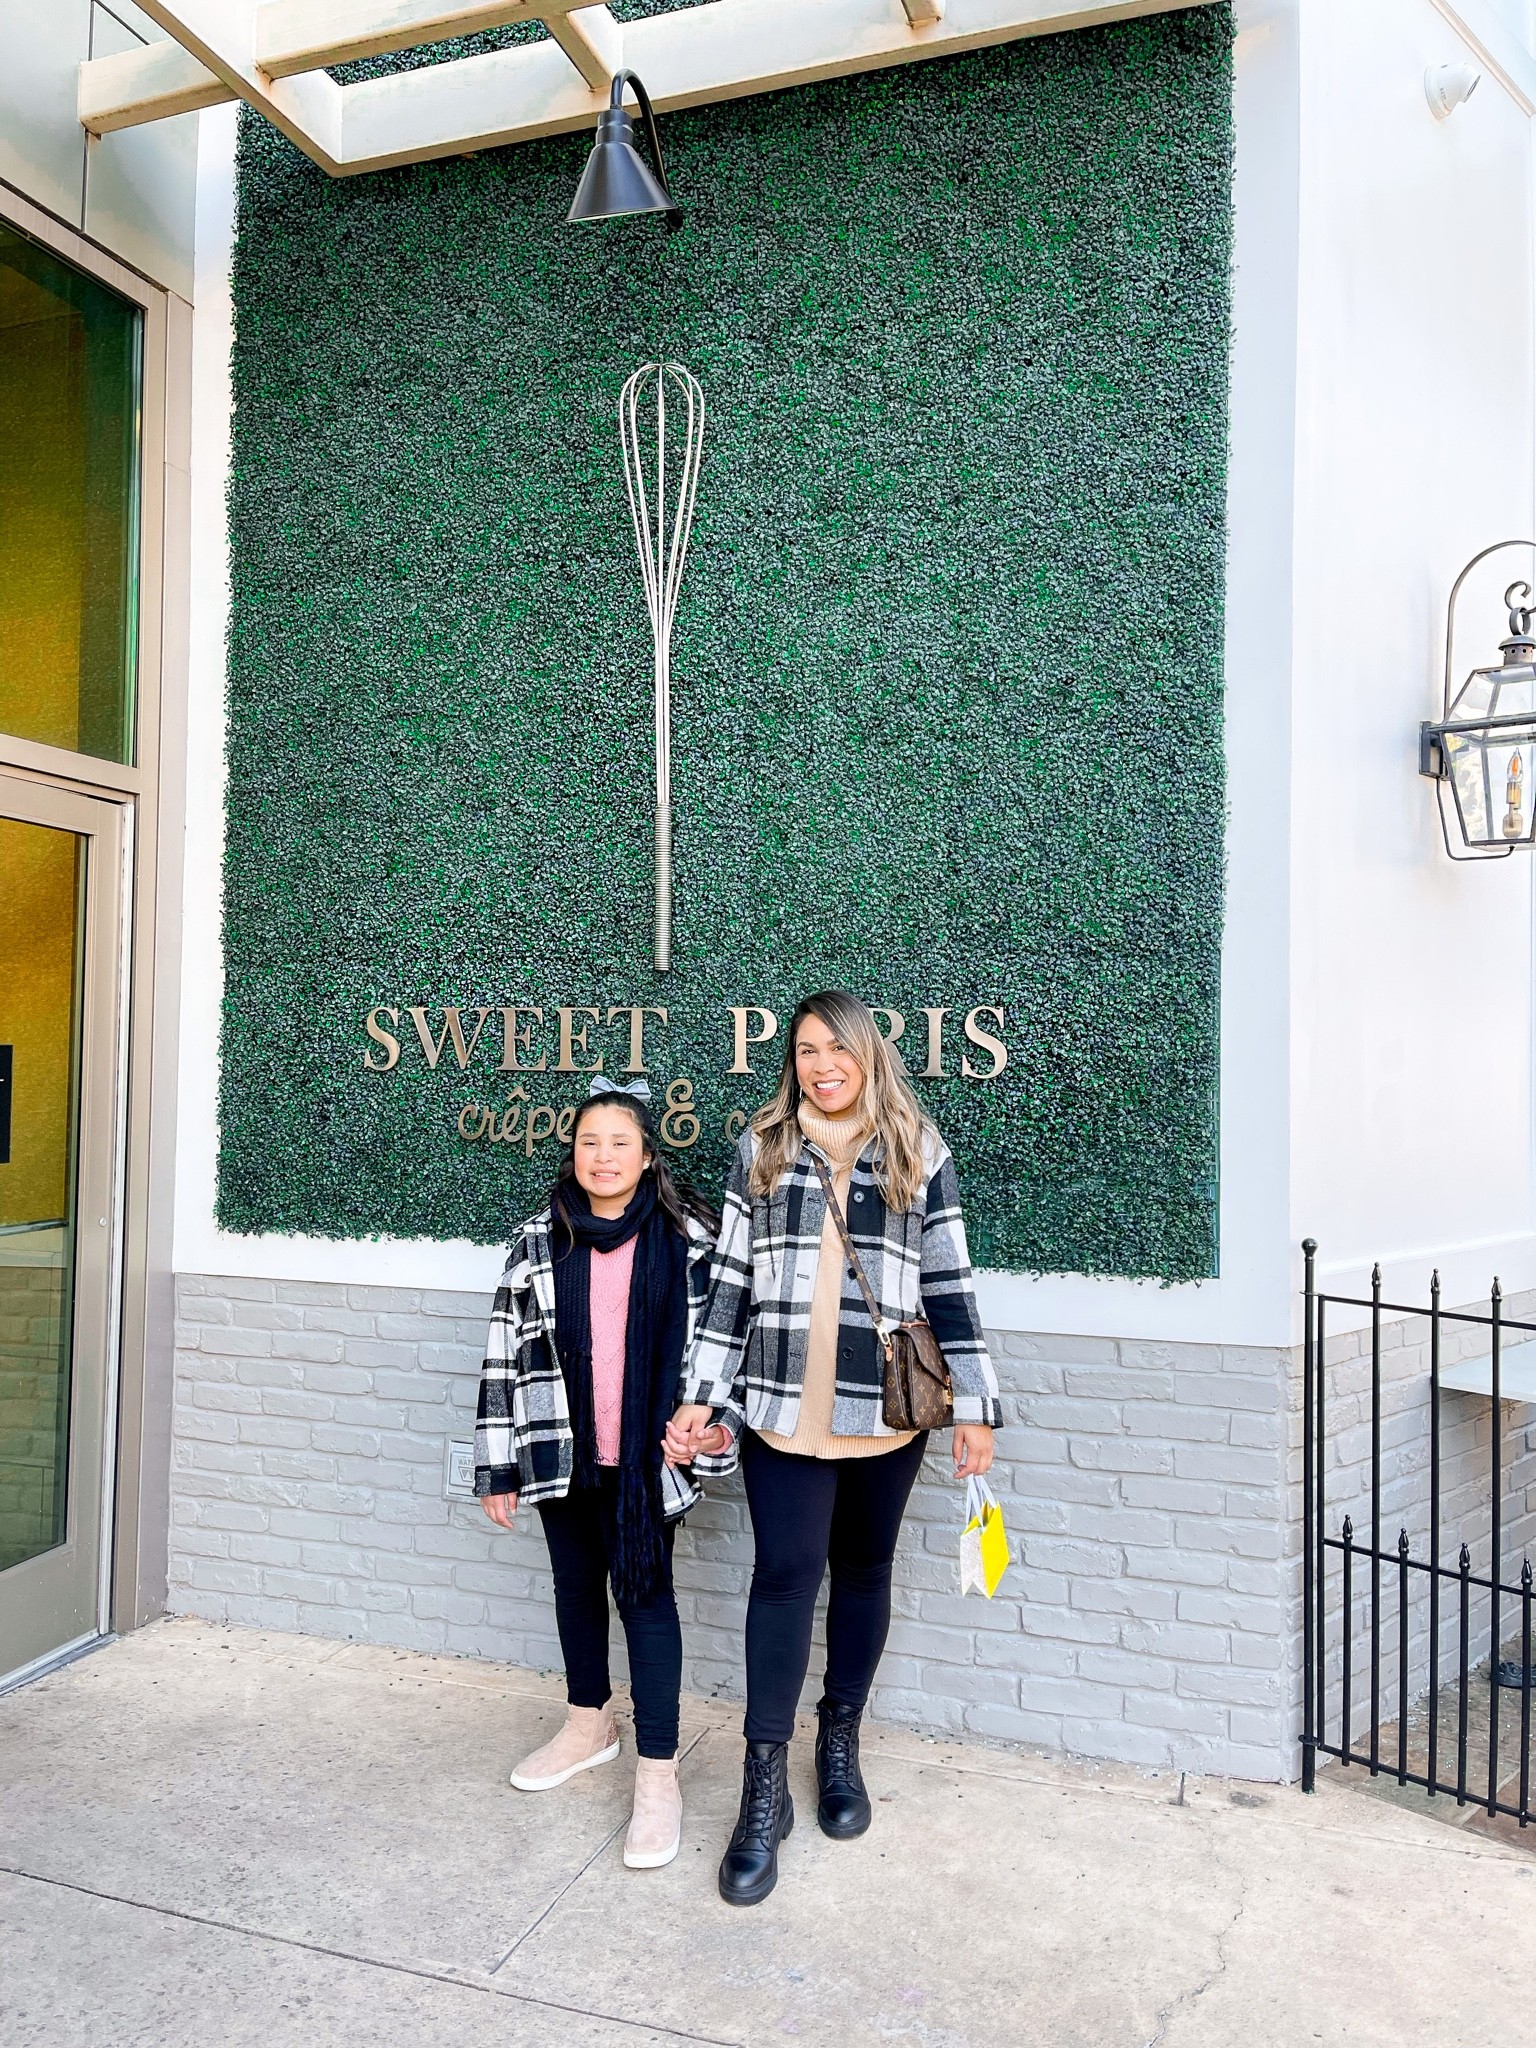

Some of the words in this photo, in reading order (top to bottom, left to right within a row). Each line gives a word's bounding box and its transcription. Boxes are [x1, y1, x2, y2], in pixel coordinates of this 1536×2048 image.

[363, 1006, 669, 1073] SWEET
[725, 1005, 1009, 1079] PRIS
[457, 1086, 576, 1157] crêpe
[660, 1078, 701, 1148] &
[458, 1458, 475, 1466] WATE
